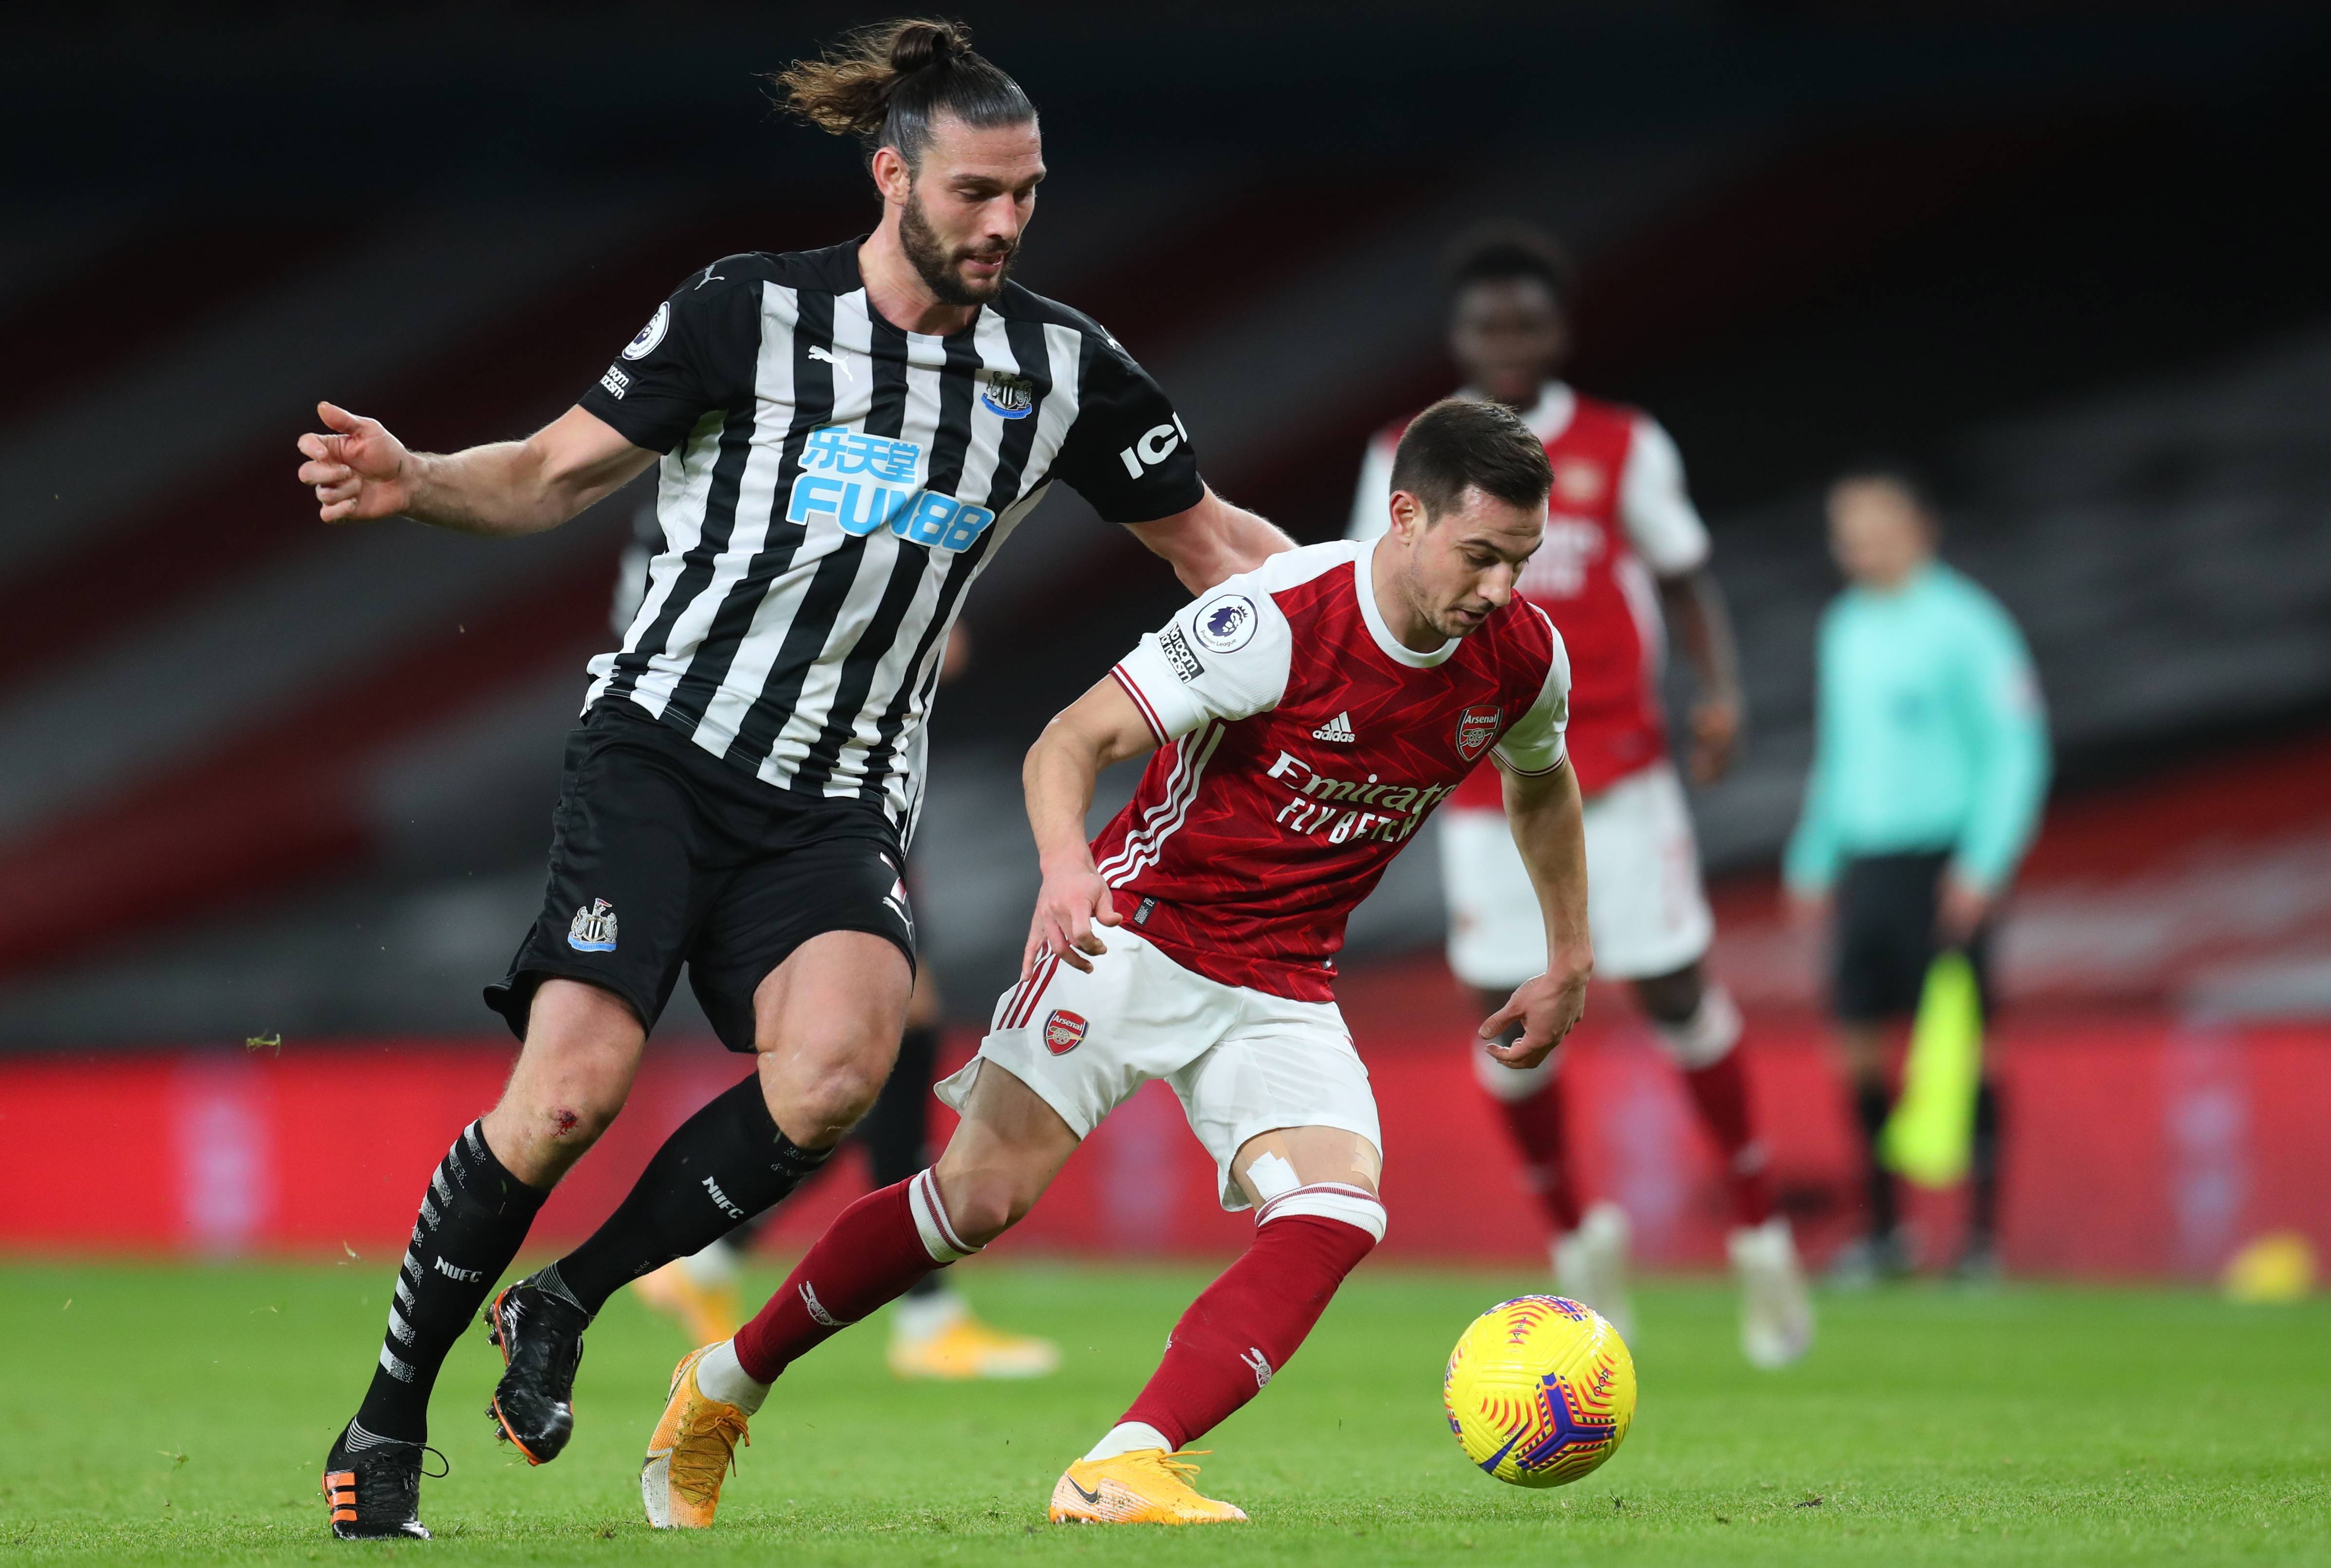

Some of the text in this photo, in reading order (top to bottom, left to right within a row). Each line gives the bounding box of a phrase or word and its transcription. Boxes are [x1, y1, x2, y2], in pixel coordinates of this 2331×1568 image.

[801, 427, 921, 484] 乐天堂
[789, 476, 993, 550] FUN88
[1173, 637, 1198, 673] room
[1200, 630, 1237, 648] Premier League
[1163, 645, 1192, 683] racism
[1313, 730, 1355, 743] adidas
[1465, 714, 1497, 724] Arsenal
[1276, 797, 1337, 835] FLY
[1053, 1015, 1083, 1031] Arsenal
[701, 1176, 744, 1219] NUFC
[434, 1255, 483, 1283] NUFC
